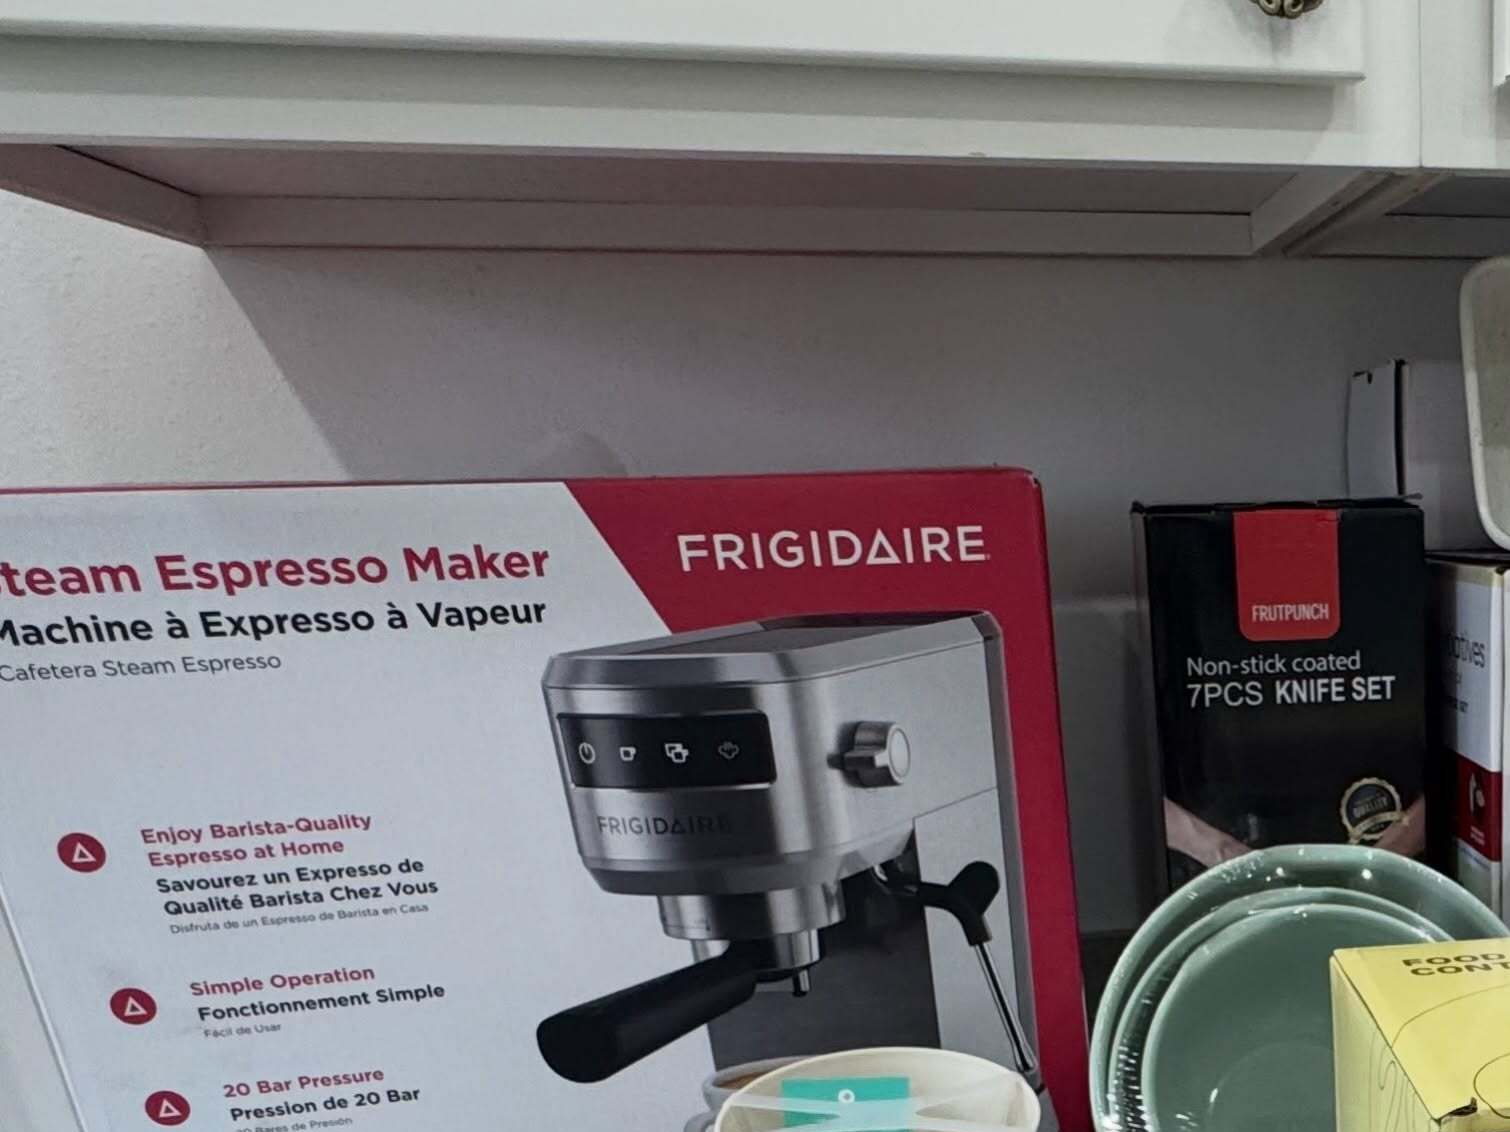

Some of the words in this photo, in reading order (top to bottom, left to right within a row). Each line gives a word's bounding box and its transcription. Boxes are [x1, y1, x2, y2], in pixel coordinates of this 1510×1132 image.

[676, 525, 988, 572] FRIGIDAIRE
[0, 562, 142, 597] team
[154, 554, 388, 596] Espresso
[403, 544, 549, 582] Maker
[166, 610, 189, 639] à
[198, 610, 375, 641] Expresso
[387, 602, 408, 629] à
[416, 602, 546, 631] Vapeur
[1251, 603, 1329, 622] FRUTPUNCH
[0, 662, 97, 682] Cafetera
[102, 659, 176, 677] Steam
[182, 655, 281, 674] Espresso
[1187, 653, 1287, 676] Non-stick
[1291, 650, 1361, 673] coated
[1187, 681, 1264, 708] 7PCS
[1275, 677, 1346, 705] KNIFE
[1351, 675, 1396, 701] SET
[140, 826, 202, 845] Enjoy
[209, 813, 371, 839] Barista-Quality
[148, 847, 247, 868] Espresso
[253, 844, 275, 859] at
[281, 838, 345, 857] Home
[156, 873, 256, 893] Savourez
[263, 870, 291, 885] un
[296, 861, 392, 883] Expresso
[398, 858, 425, 874] de
[163, 894, 244, 916] Qualité
[249, 889, 325, 909] Barista
[329, 884, 383, 902] Chez
[386, 880, 439, 897] Vous
[169, 918, 220, 935] Disfruta
[223, 918, 240, 931] de
[242, 917, 259, 929] un
[261, 913, 316, 927] Espresso
[319, 910, 335, 923] de
[337, 906, 379, 920] Barista
[381, 905, 398, 917] en
[399, 902, 429, 915] Casa
[1401, 953, 1505, 967] FOOD
[190, 977, 264, 997] Simple
[269, 967, 375, 989] Operation
[197, 990, 371, 1022] Fonctionnement
[375, 983, 445, 1003] Simple
[223, 1082, 251, 1098] 20
[256, 1078, 292, 1095] Bar
[297, 1069, 385, 1090] Pressure
[230, 1101, 318, 1122] Pression
[323, 1096, 349, 1111] de
[354, 1091, 381, 1108] 20
[386, 1087, 421, 1103] Bar
[291, 1121, 307, 1132] de
